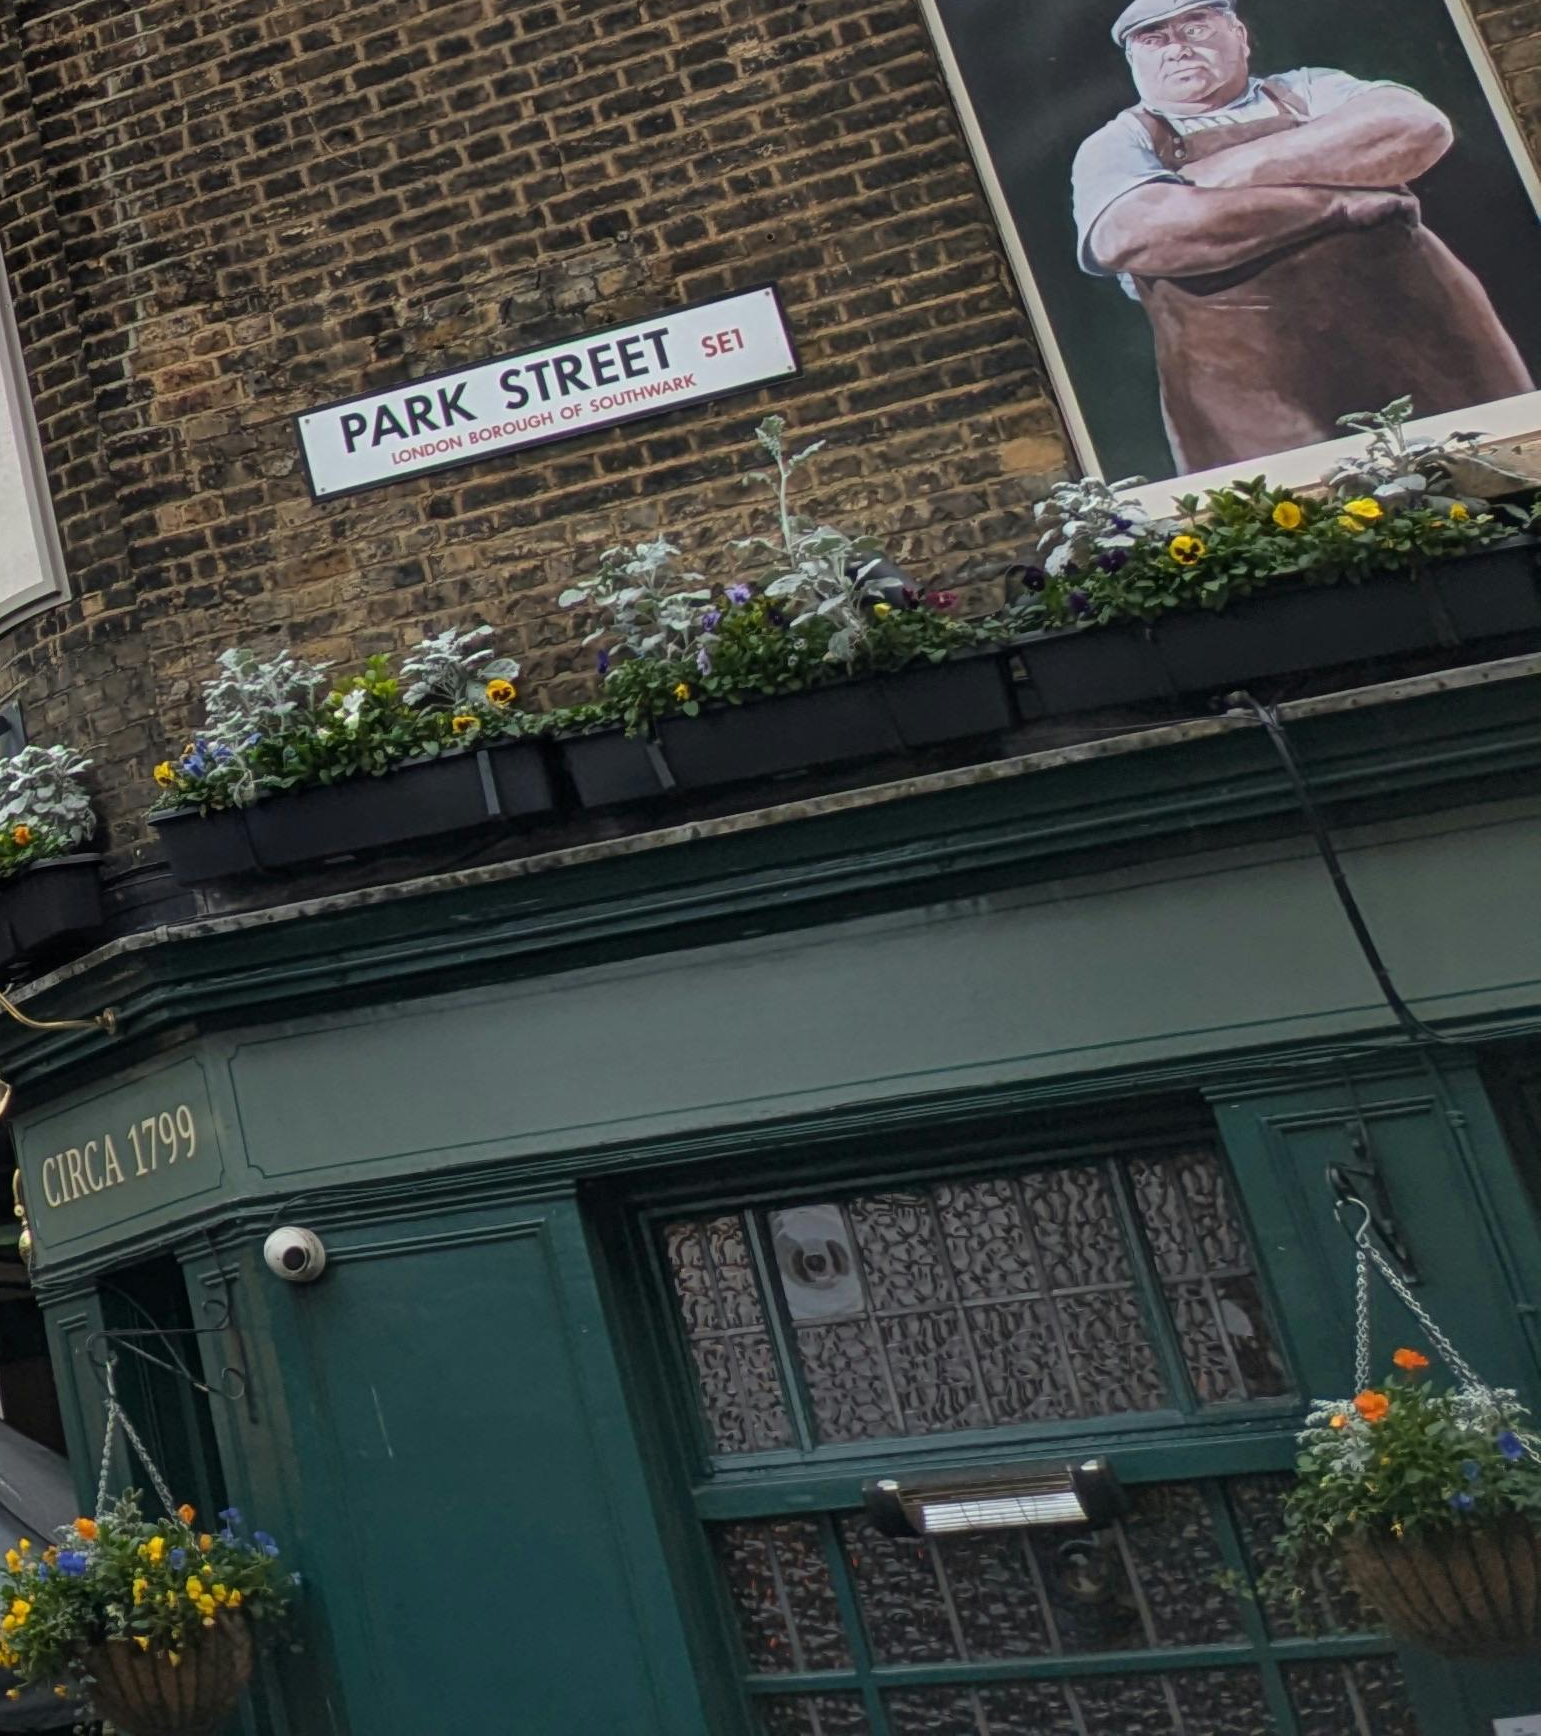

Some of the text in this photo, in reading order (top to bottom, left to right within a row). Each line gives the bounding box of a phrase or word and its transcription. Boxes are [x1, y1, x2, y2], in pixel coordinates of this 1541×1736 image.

[339, 327, 746, 454] PARK STREET SE1
[390, 372, 697, 466] LONDON BOROUGH OF SOUTHWARK
[42, 1104, 197, 1208] CIRCA 1799
